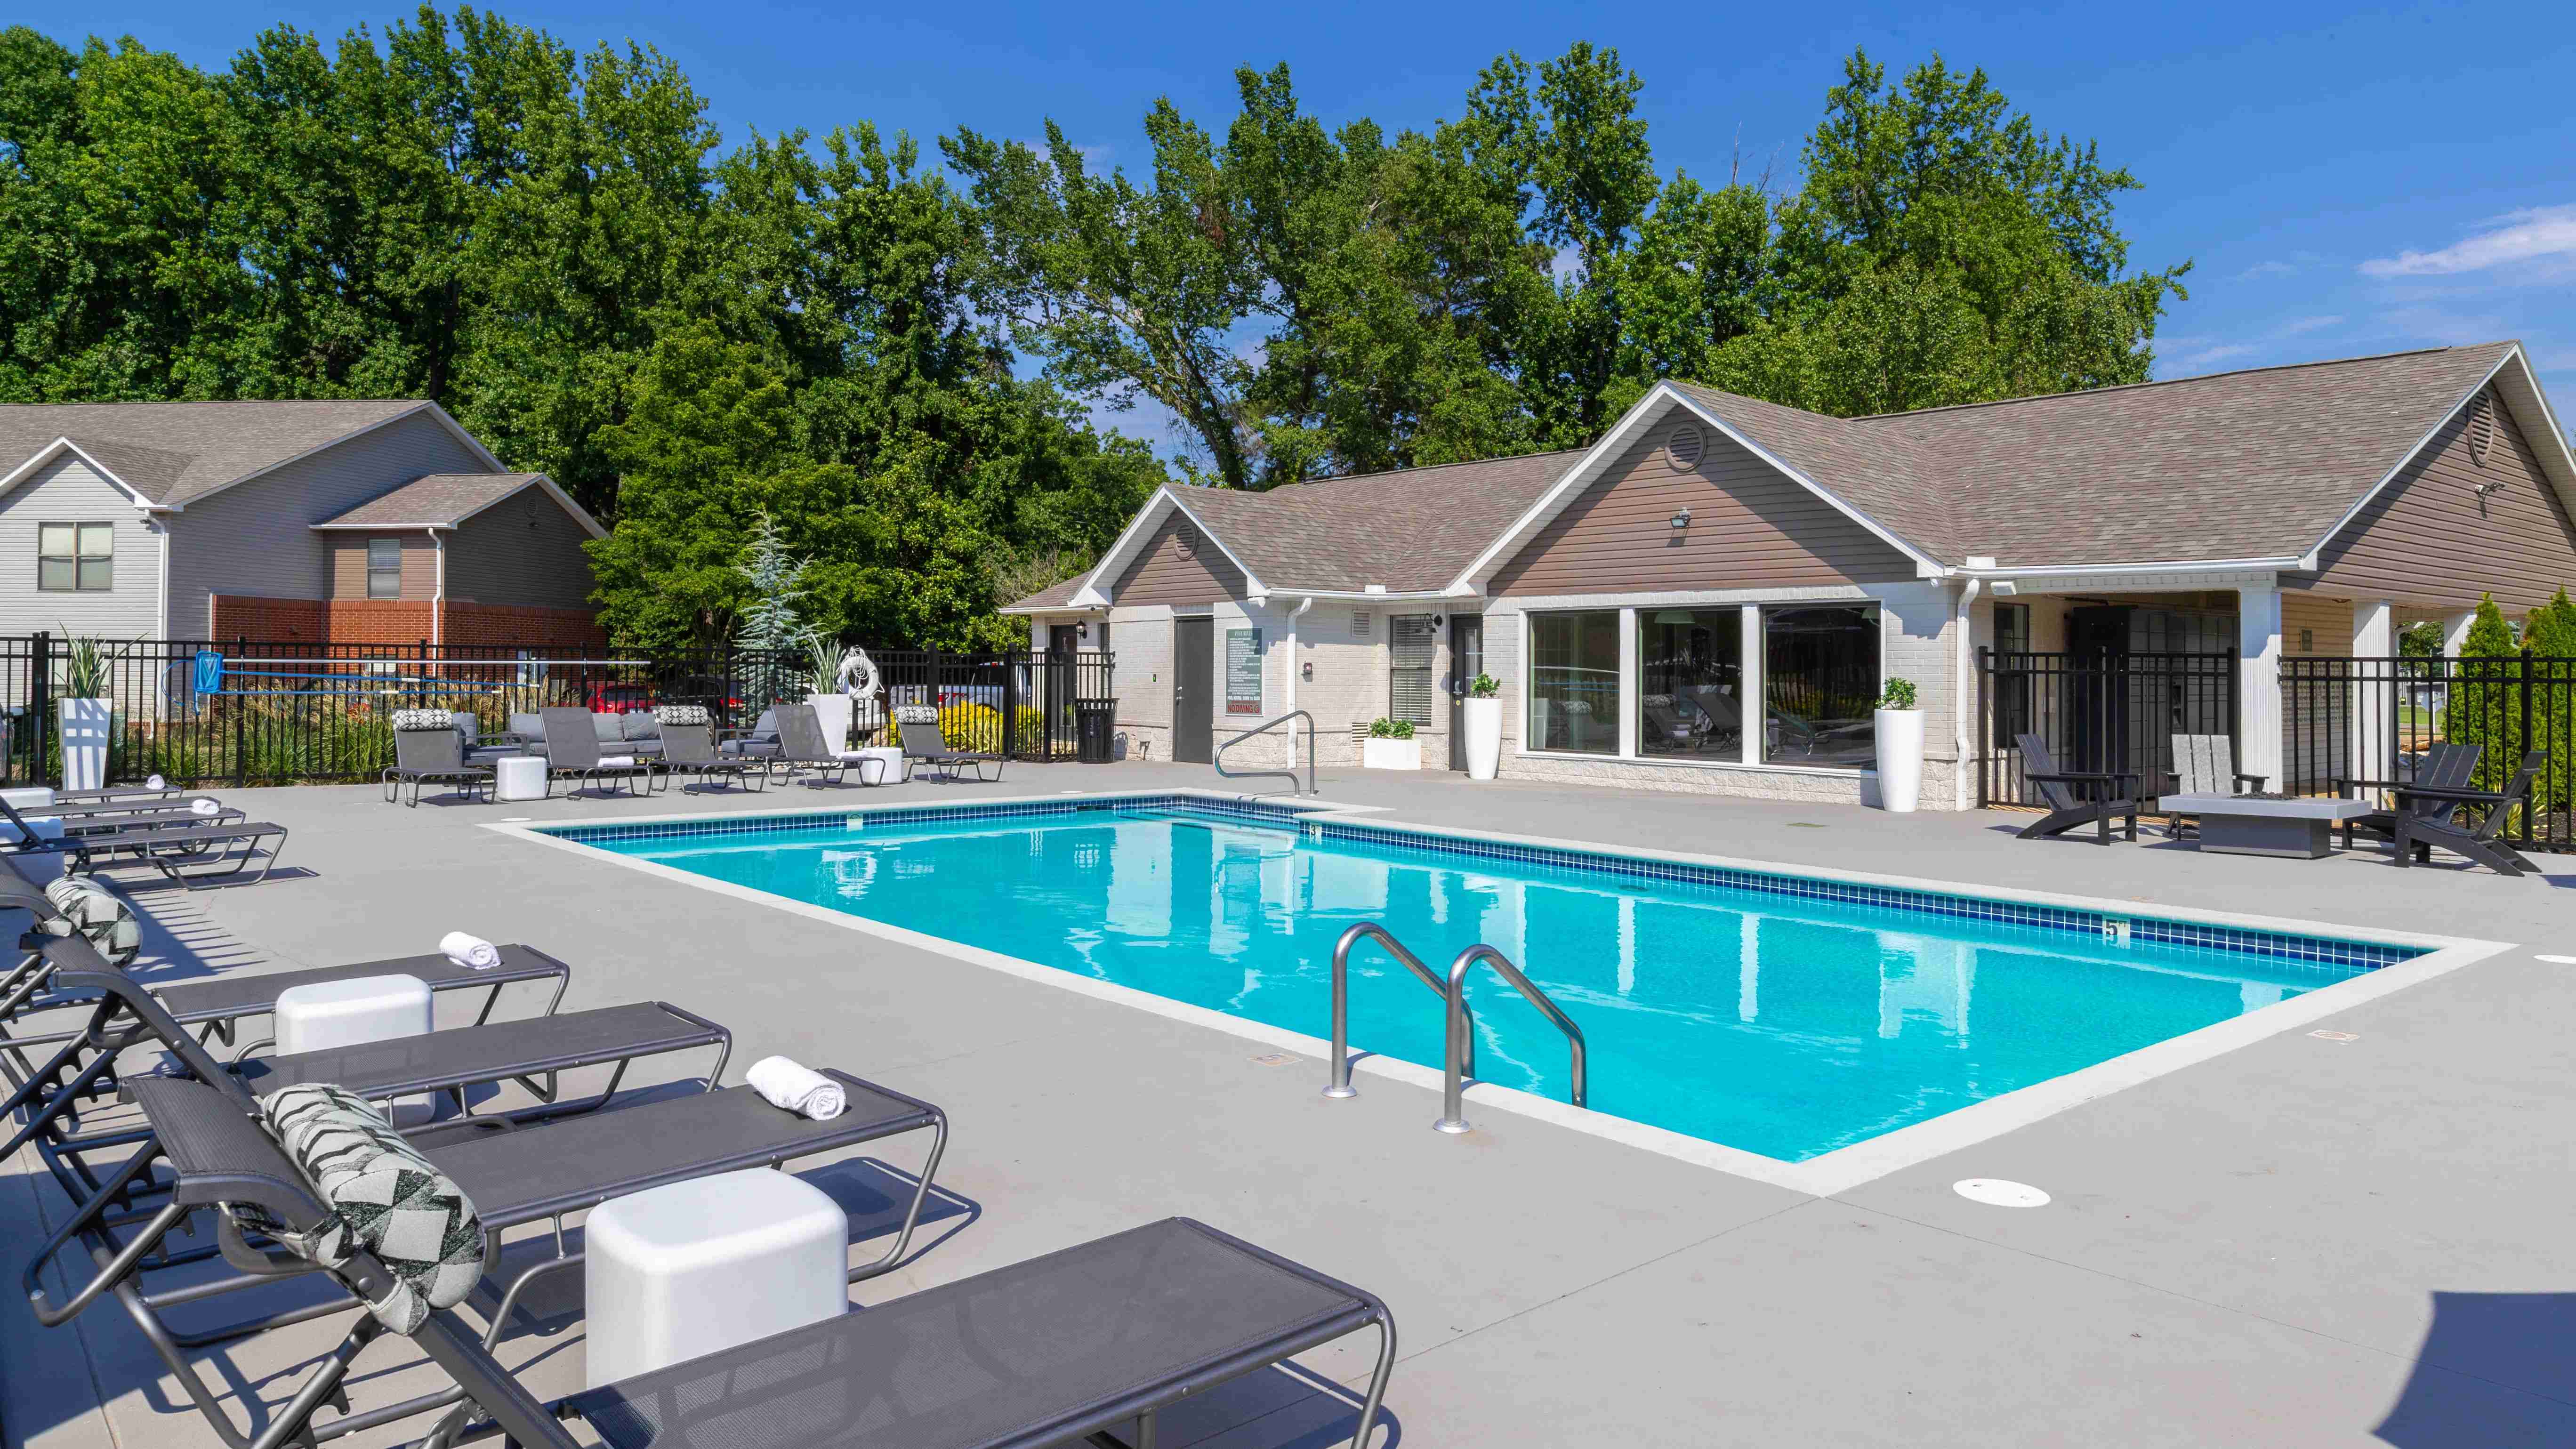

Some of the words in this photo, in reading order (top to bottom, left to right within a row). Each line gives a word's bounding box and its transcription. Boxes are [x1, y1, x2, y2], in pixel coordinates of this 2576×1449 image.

[1228, 704, 1235, 712] NO
[1236, 704, 1253, 713] DIVING
[1311, 824, 1316, 836] 3
[2106, 919, 2117, 935] 5
